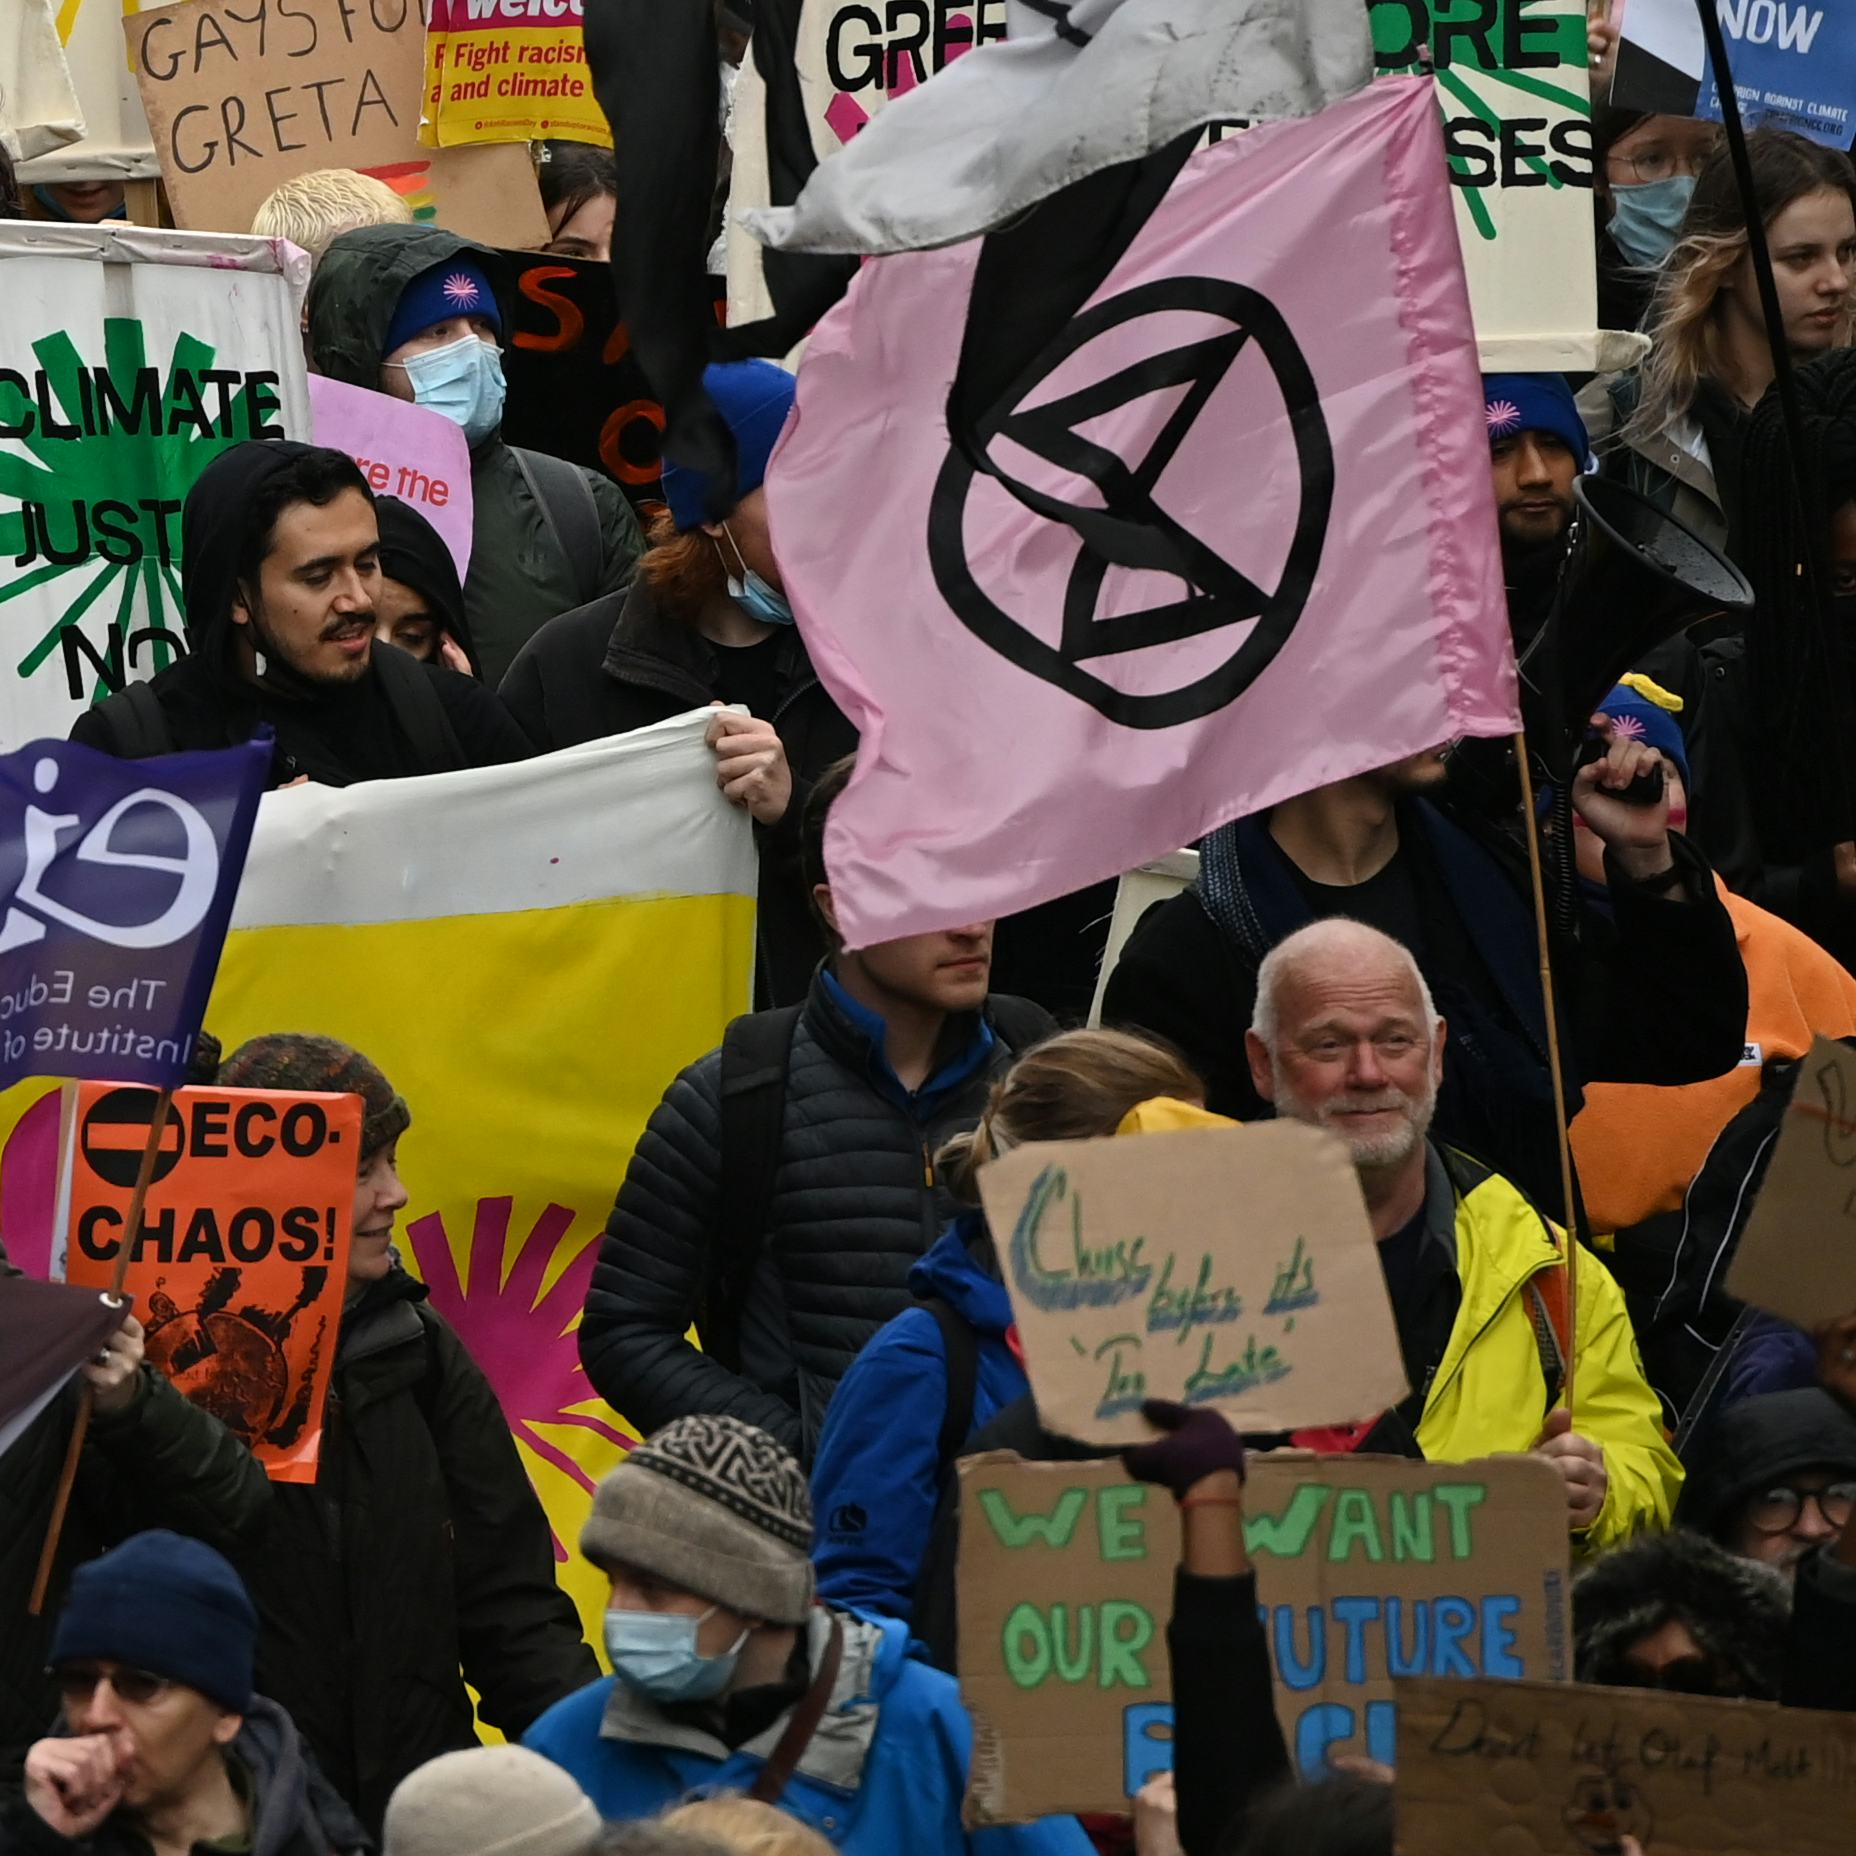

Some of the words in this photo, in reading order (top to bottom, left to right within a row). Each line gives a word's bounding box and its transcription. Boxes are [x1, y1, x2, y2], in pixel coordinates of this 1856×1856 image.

[454, 41, 509, 69] Fight
[450, 74, 490, 102] and
[497, 73, 585, 98] climate
[171, 69, 398, 173] GRETA
[397, 466, 449, 506] the
[189, 1100, 341, 1158] ECO-
[76, 1205, 338, 1263] CHAOS!
[978, 1484, 1148, 1562] WE
[1243, 1481, 1486, 1564] WANT
[1002, 1600, 1155, 1691] OUR
[1274, 1593, 1525, 1691] UTURE
